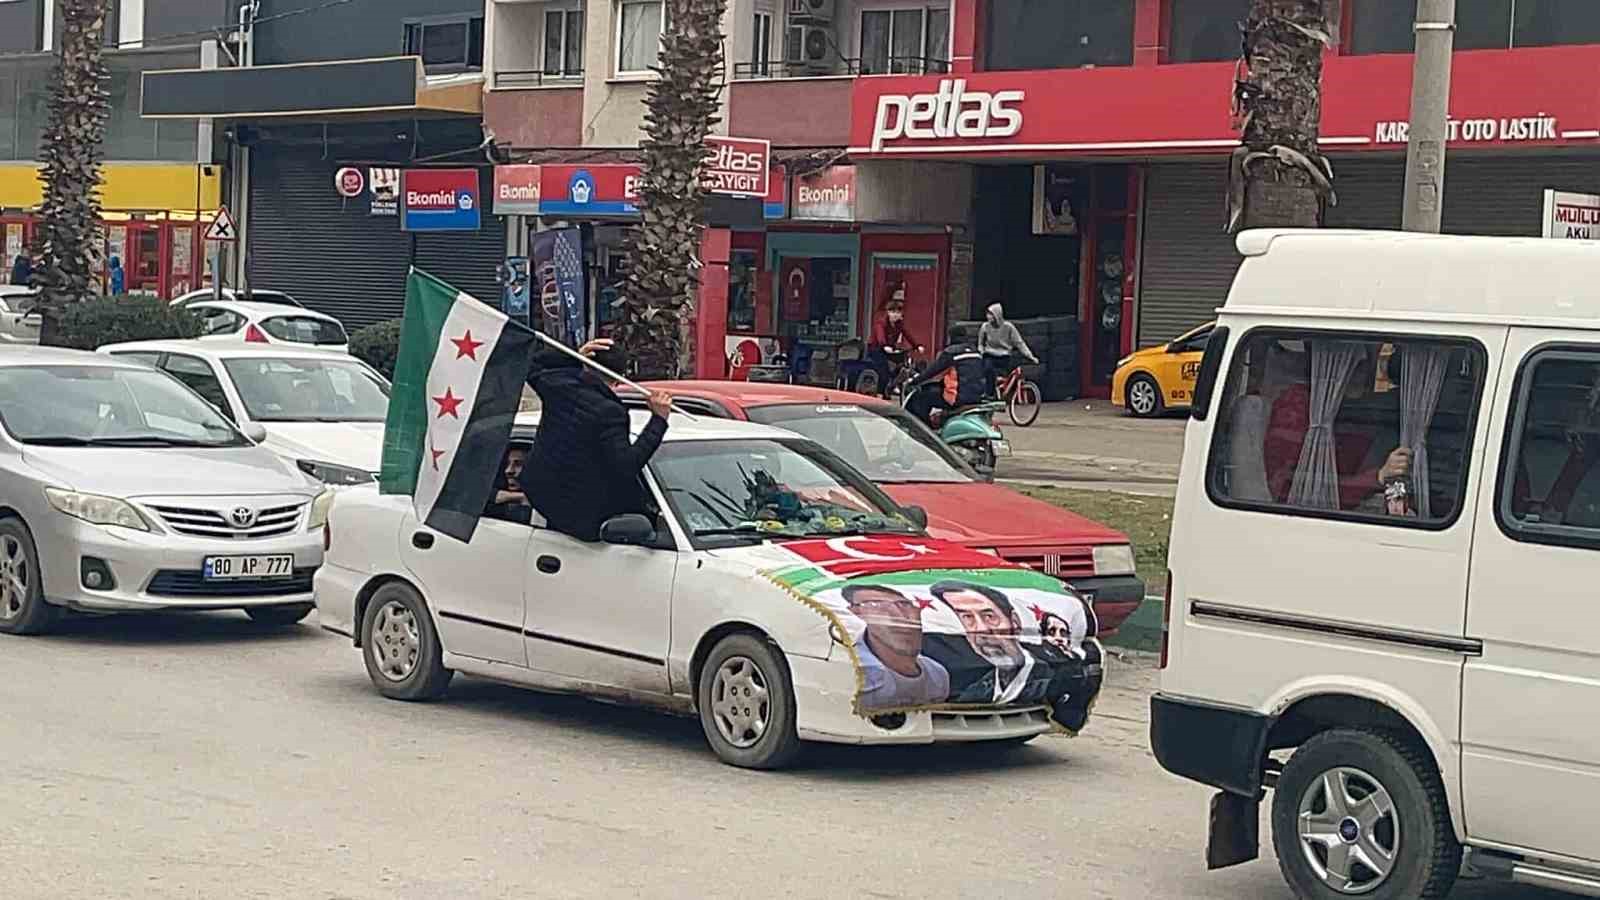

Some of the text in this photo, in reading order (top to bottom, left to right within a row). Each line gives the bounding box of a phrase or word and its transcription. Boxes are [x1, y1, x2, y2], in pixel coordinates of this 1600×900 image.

[871, 78, 1025, 152] petlas
[1462, 118, 1498, 141] OTO
[1499, 111, 1557, 140] LASTİK
[703, 144, 763, 171] etlas
[407, 189, 455, 205] Ekomini
[501, 182, 541, 200] Ekomini
[799, 183, 849, 203] Ekomini
[214, 557, 290, 575] 80 AP 777
